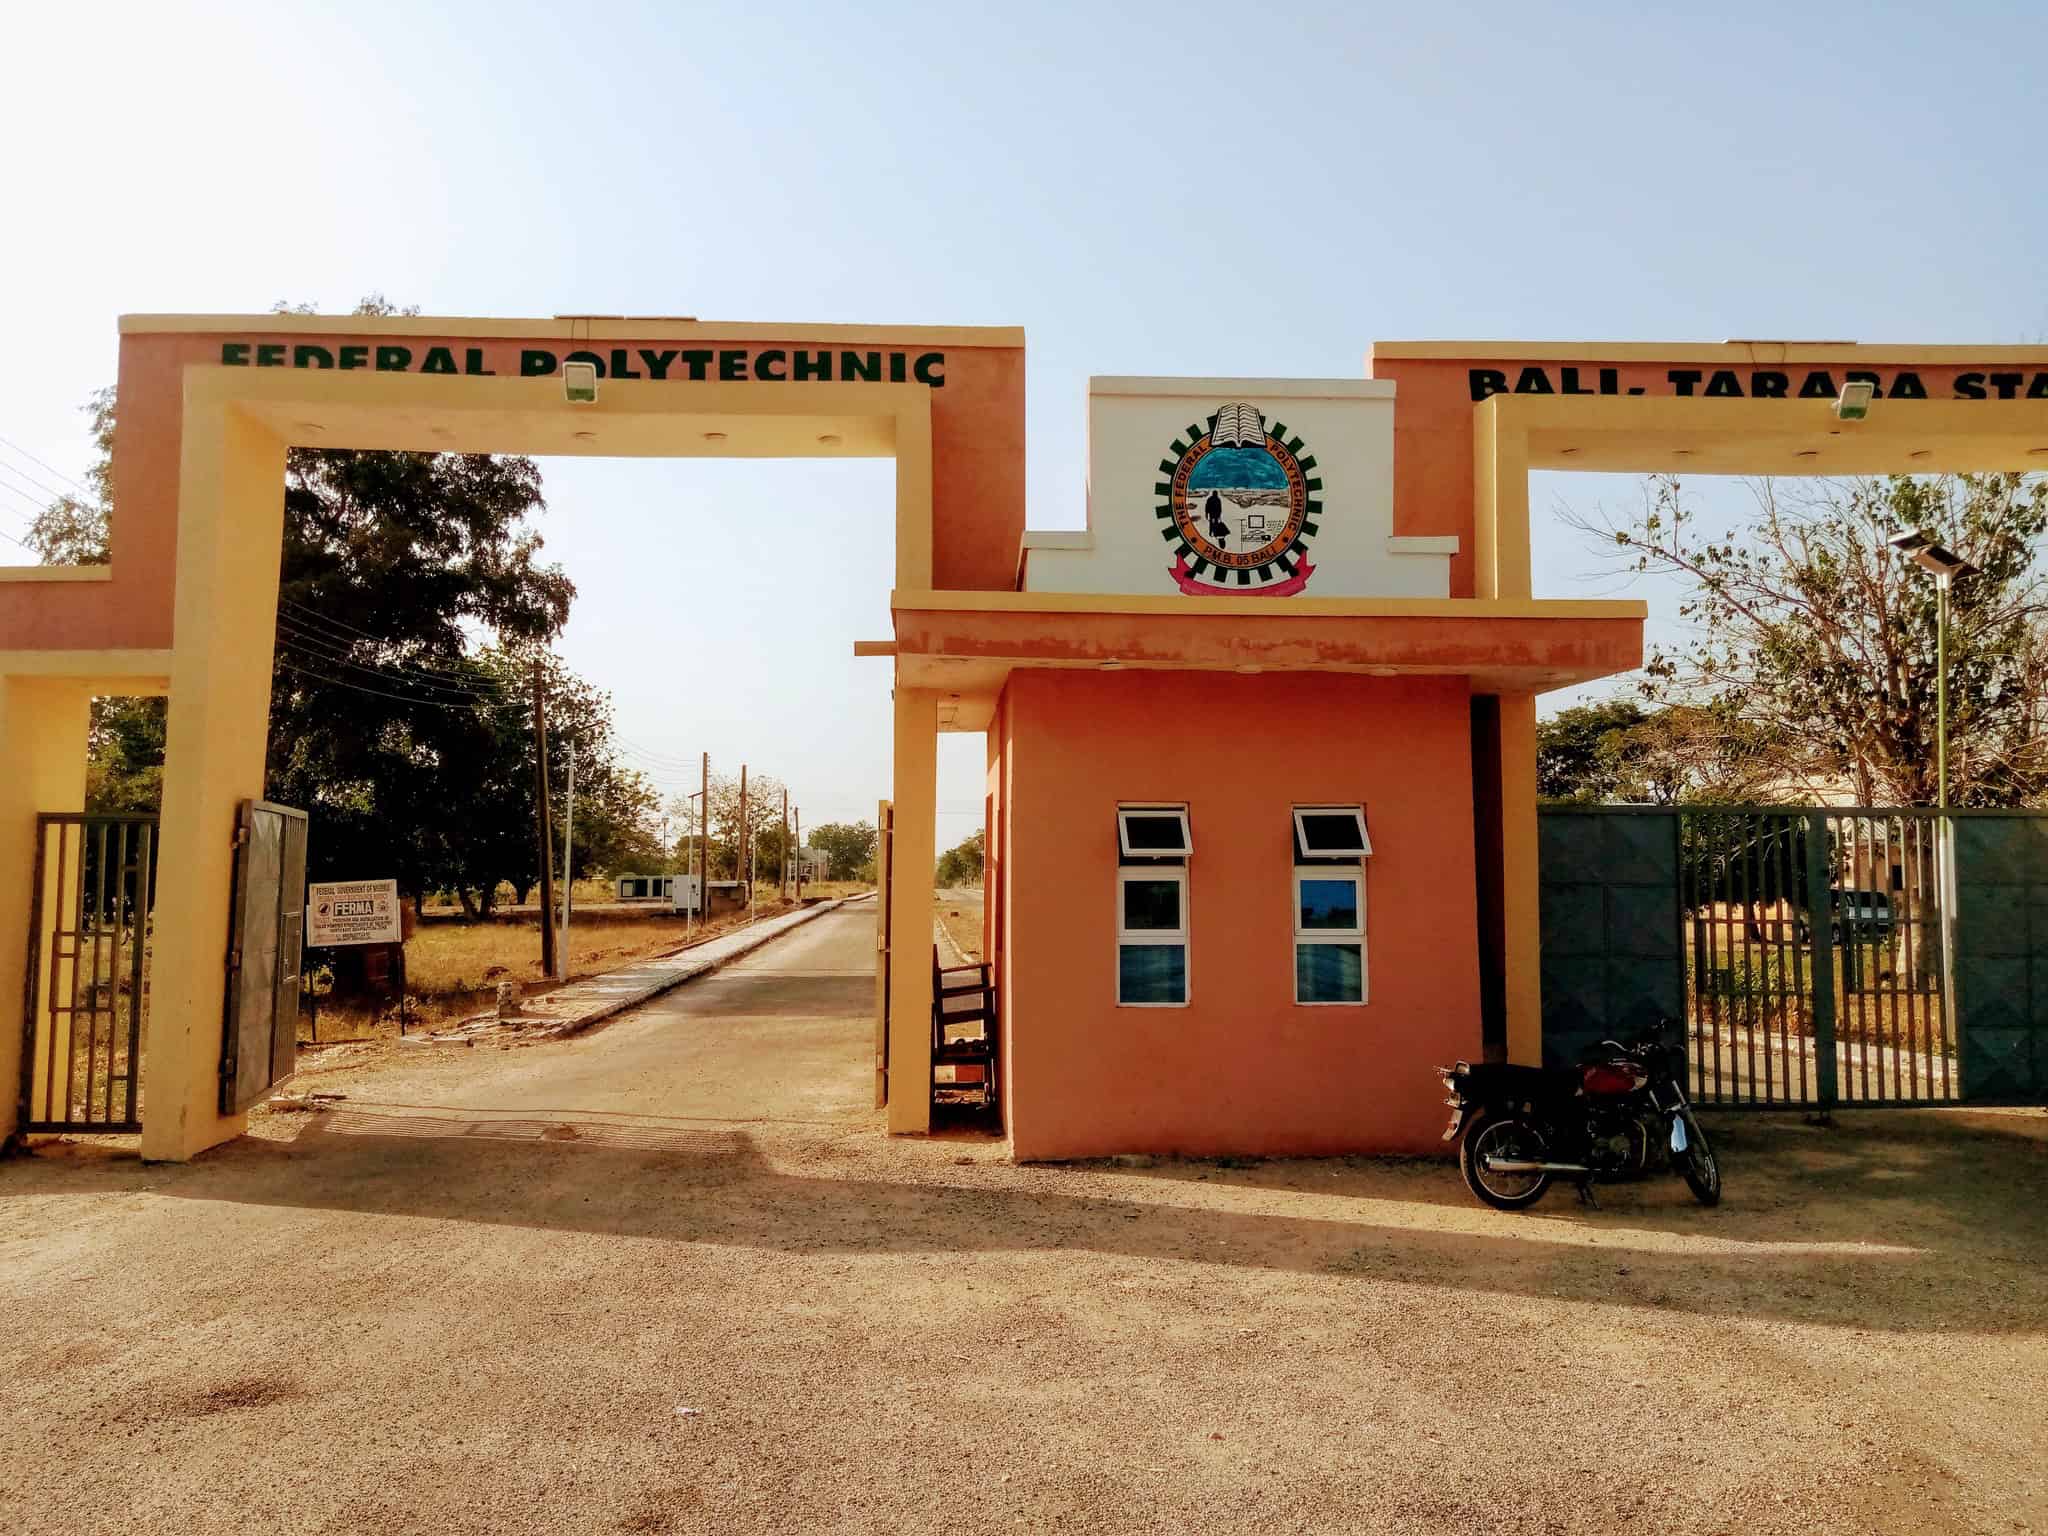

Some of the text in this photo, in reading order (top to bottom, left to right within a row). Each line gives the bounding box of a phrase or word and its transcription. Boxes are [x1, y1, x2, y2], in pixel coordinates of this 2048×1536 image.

[222, 344, 497, 376] FEDERAL
[1174, 443, 1303, 531] THE FEDERAL POLYTECHNIC
[1251, 545, 1276, 563] BALI
[335, 901, 373, 915] FERMA
